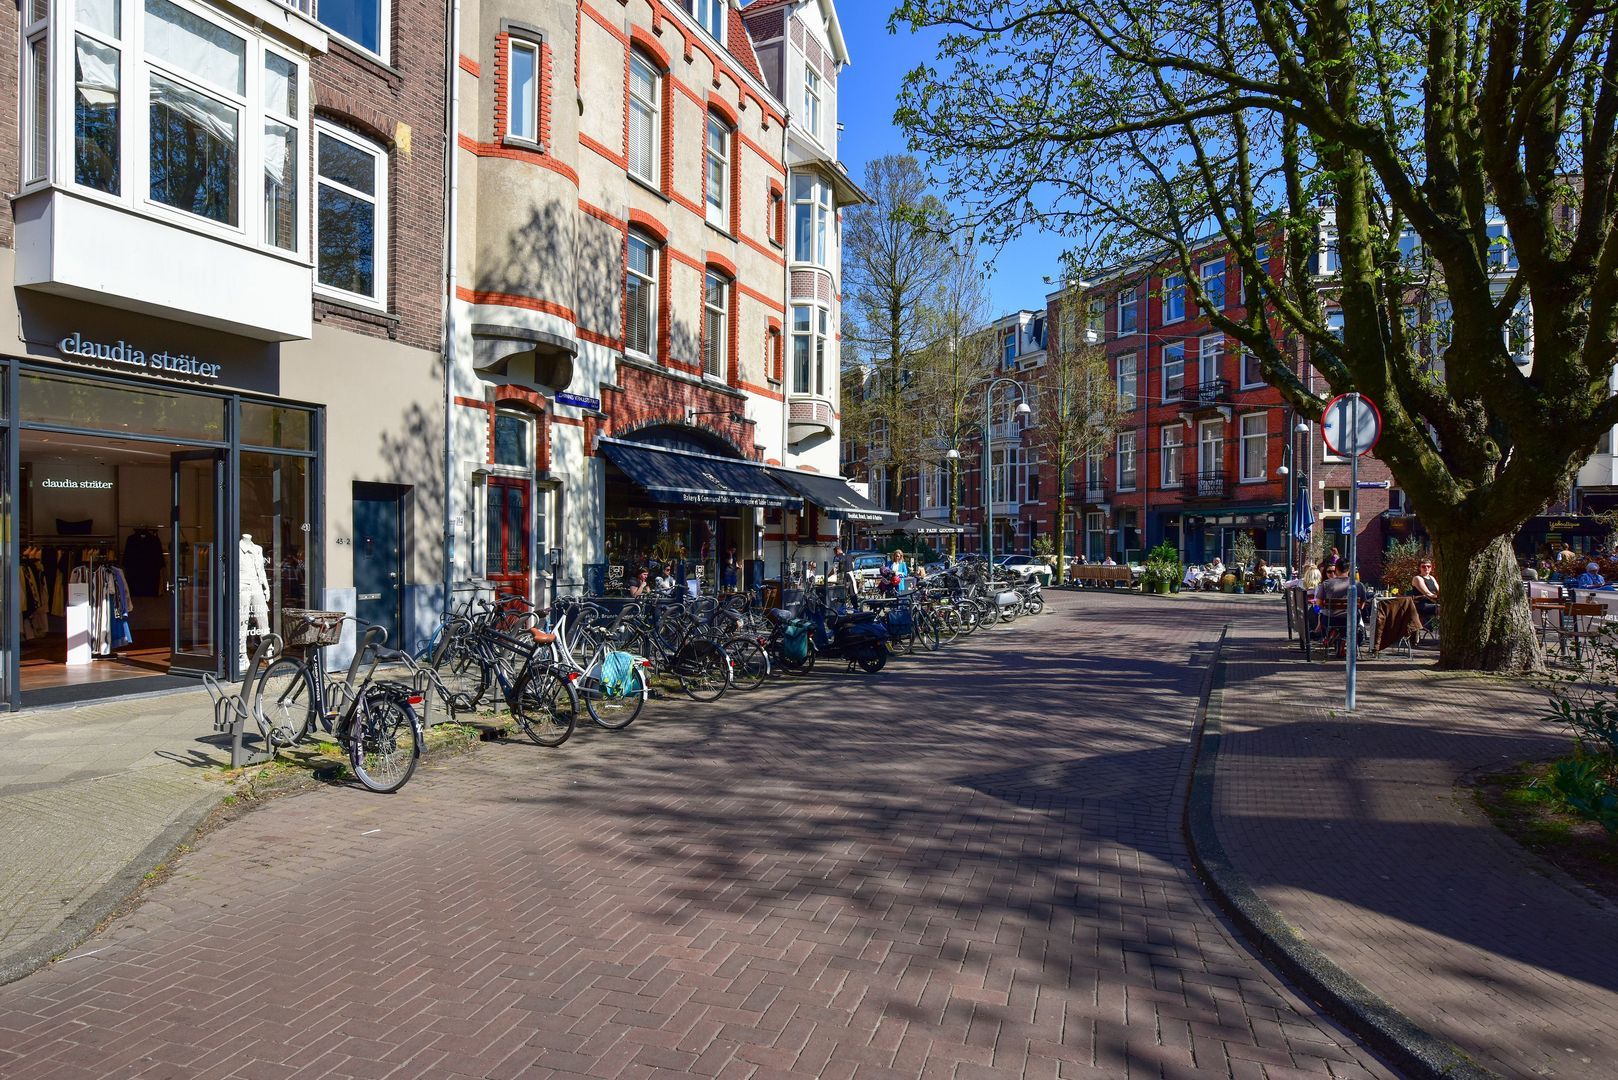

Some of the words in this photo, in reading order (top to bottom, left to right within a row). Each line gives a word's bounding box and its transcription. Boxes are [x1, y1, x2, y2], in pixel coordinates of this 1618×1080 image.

[59, 332, 147, 367] claudia
[150, 350, 222, 379] sträter
[42, 478, 78, 488] claudia
[79, 480, 113, 489] sträter
[683, 493, 697, 504] Bakery
